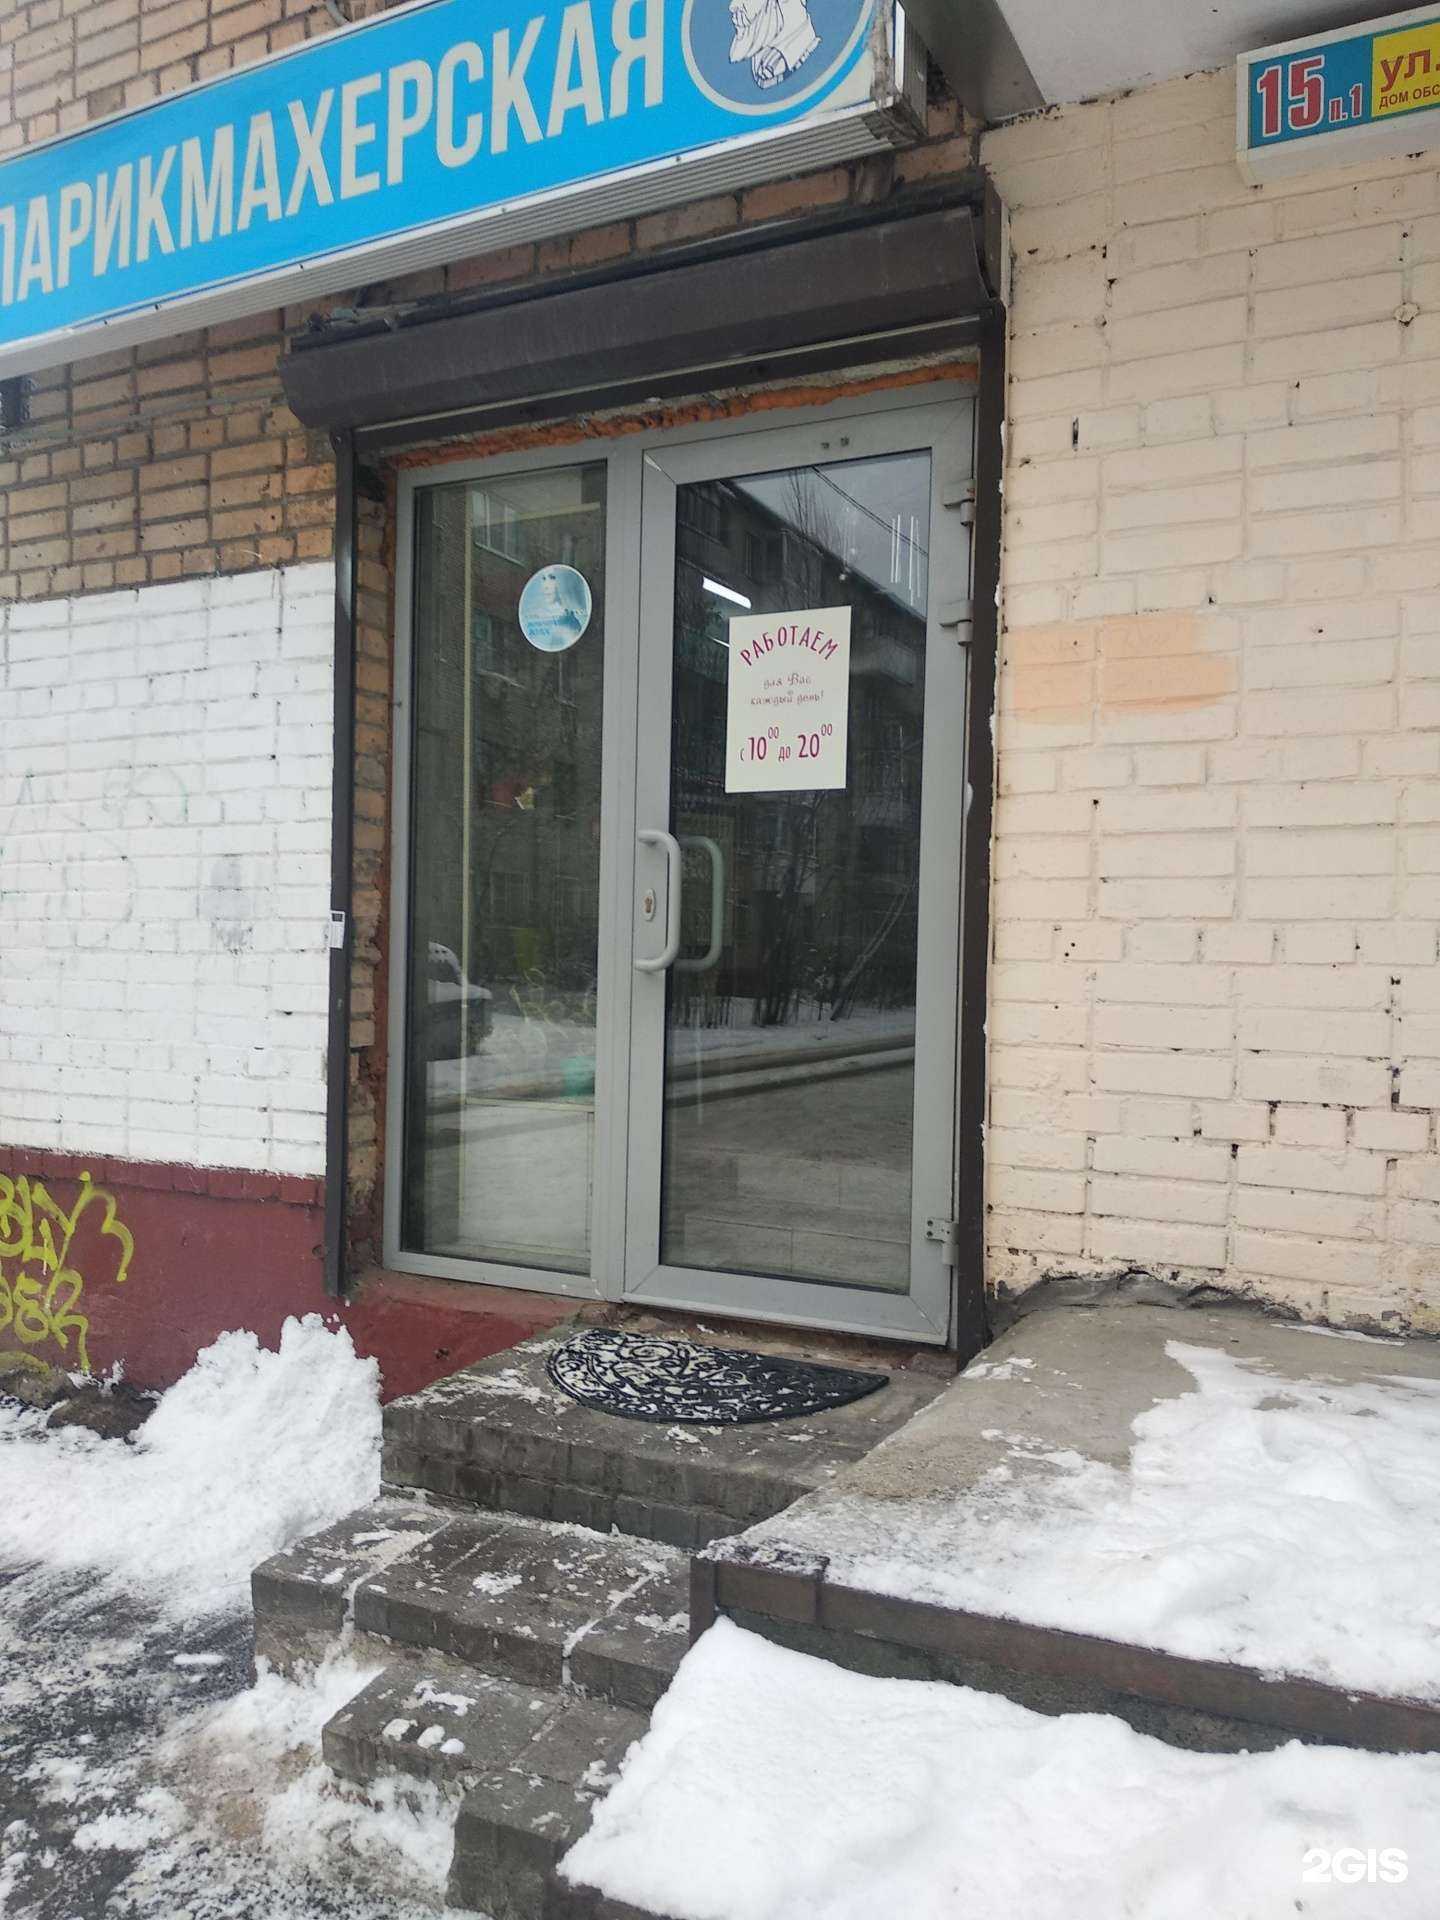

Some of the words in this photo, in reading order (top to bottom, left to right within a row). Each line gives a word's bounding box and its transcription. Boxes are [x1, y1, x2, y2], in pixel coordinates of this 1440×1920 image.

[1257, 54, 1325, 138] 15
[1379, 91, 1409, 110] ДОМ
[740, 625, 839, 667] РАБОТАЕМ
[763, 677, 783, 690] для
